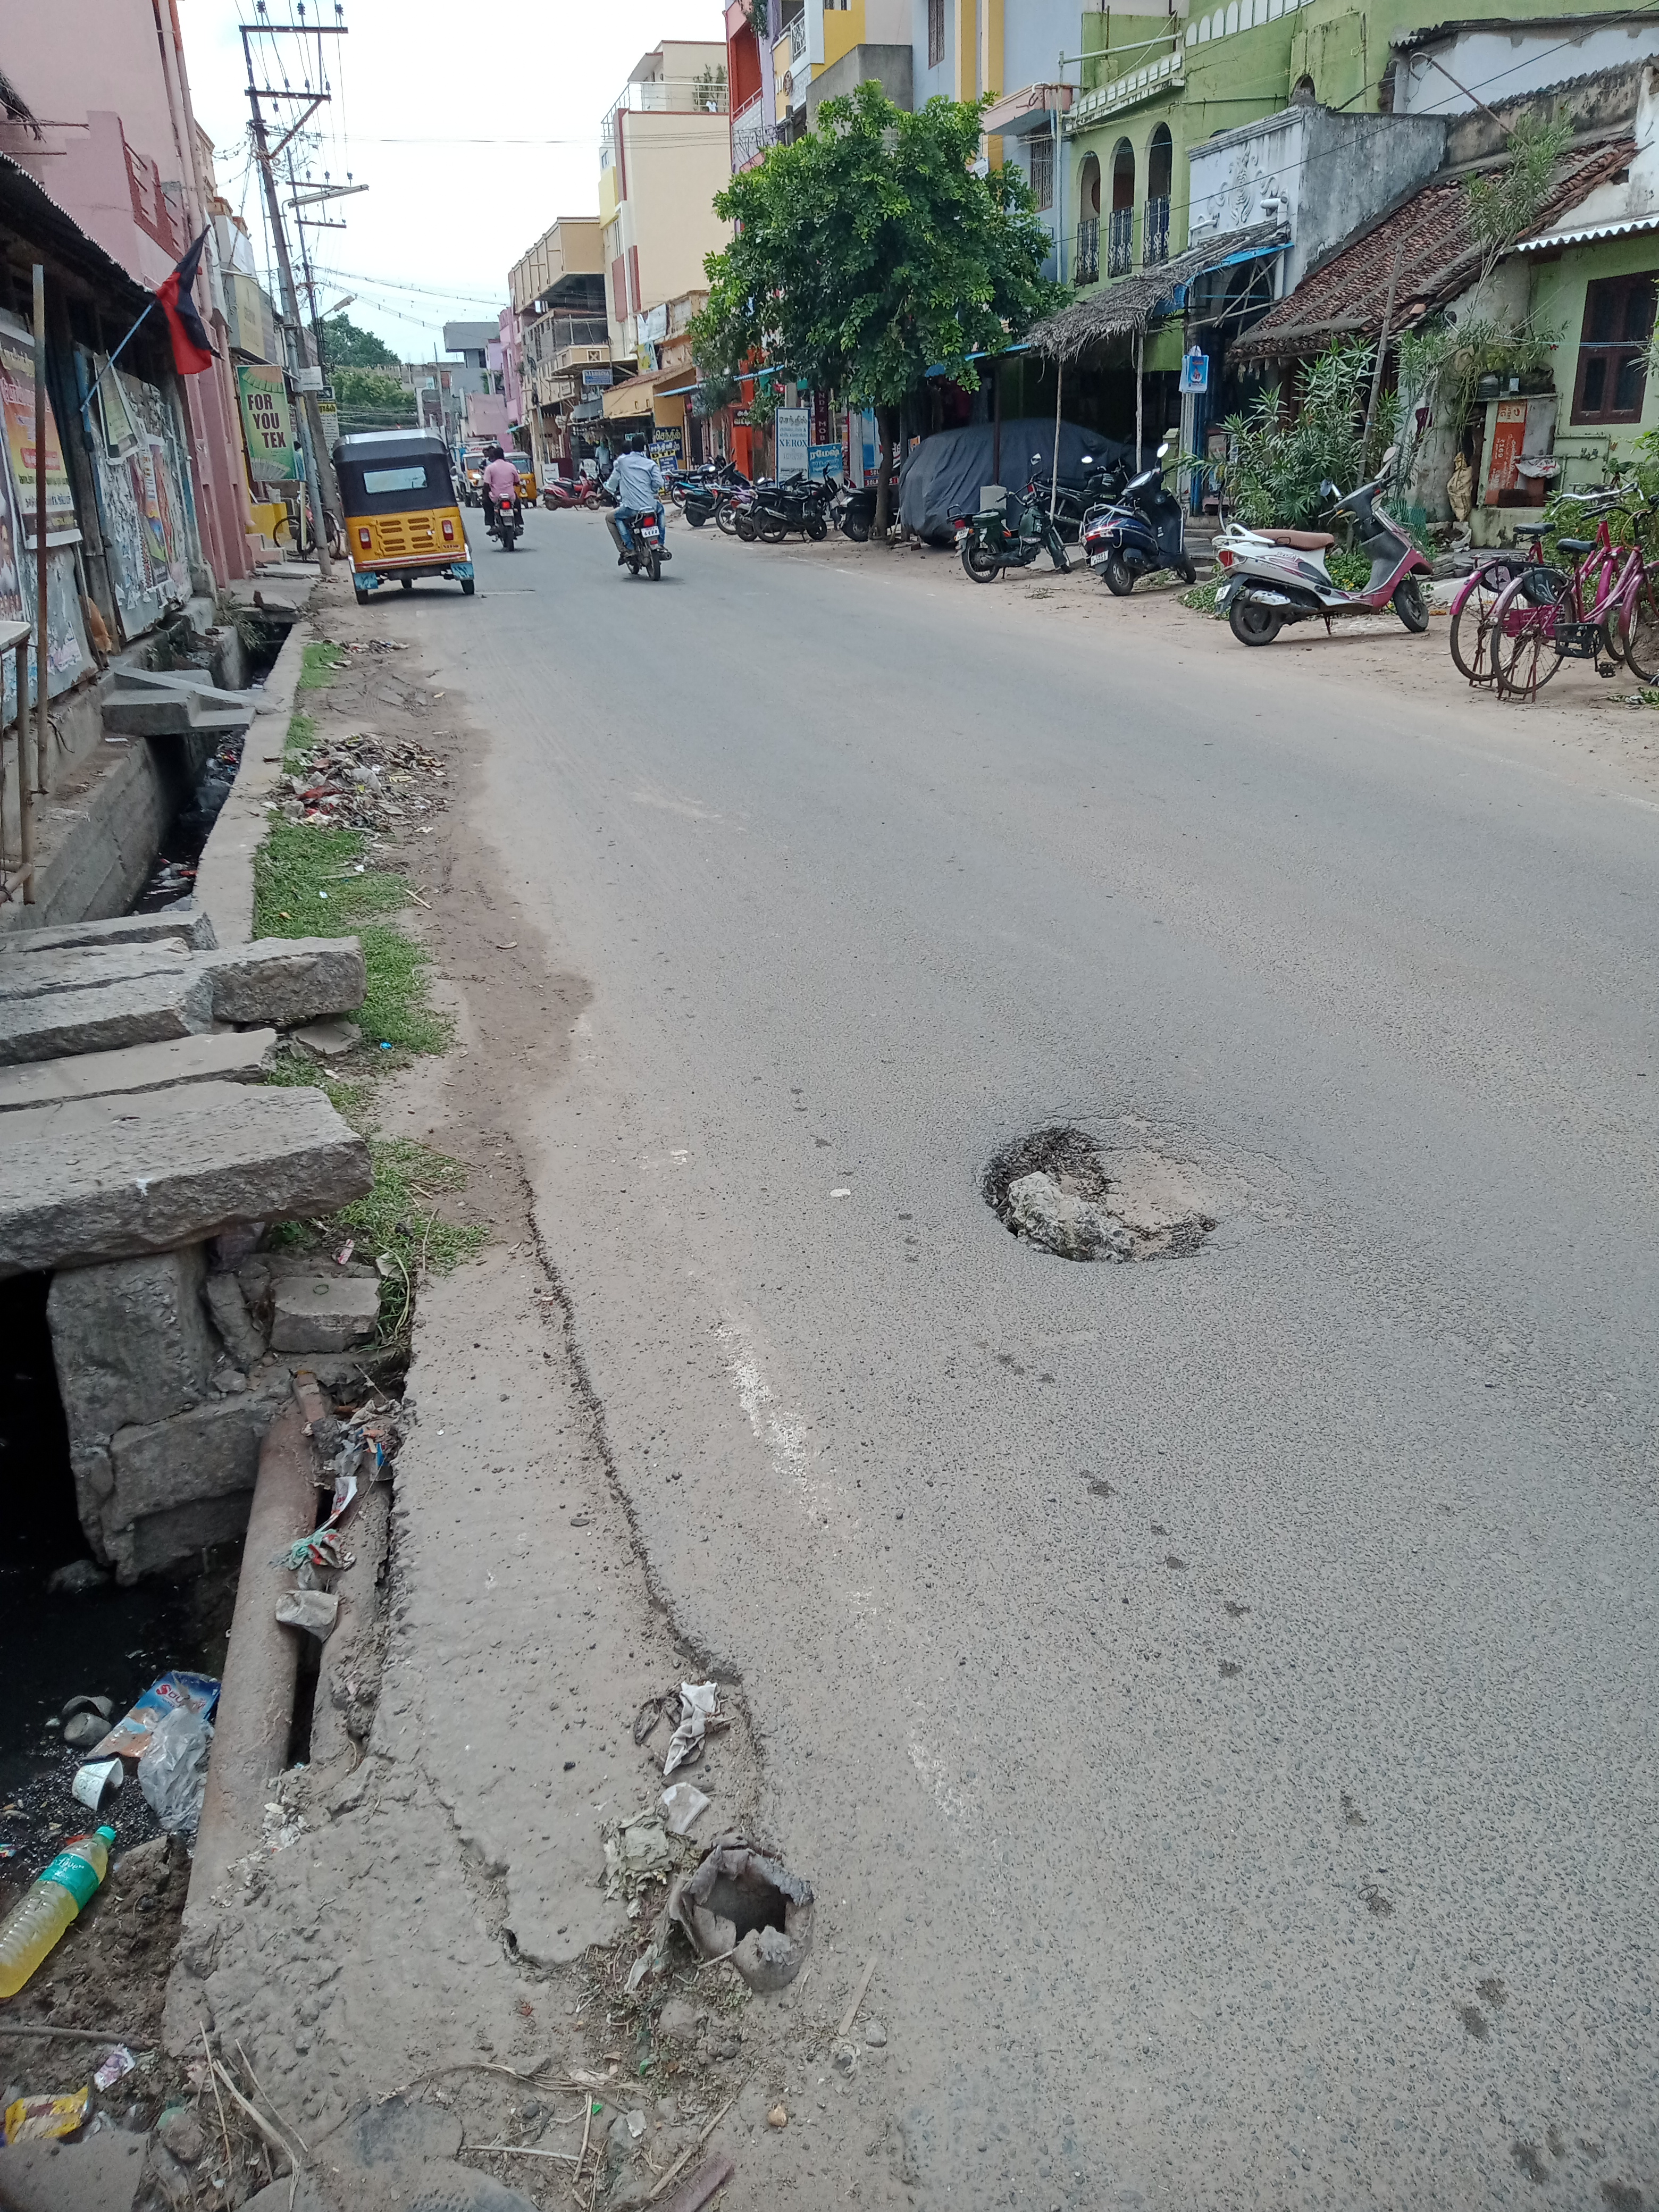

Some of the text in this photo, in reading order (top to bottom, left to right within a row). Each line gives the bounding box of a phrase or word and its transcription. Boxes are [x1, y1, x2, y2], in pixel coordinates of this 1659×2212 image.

[247, 393, 273, 410] FOR
[252, 413, 280, 430] YOU
[262, 431, 287, 448] TEX
[651, 450, 675, 458] DTP
